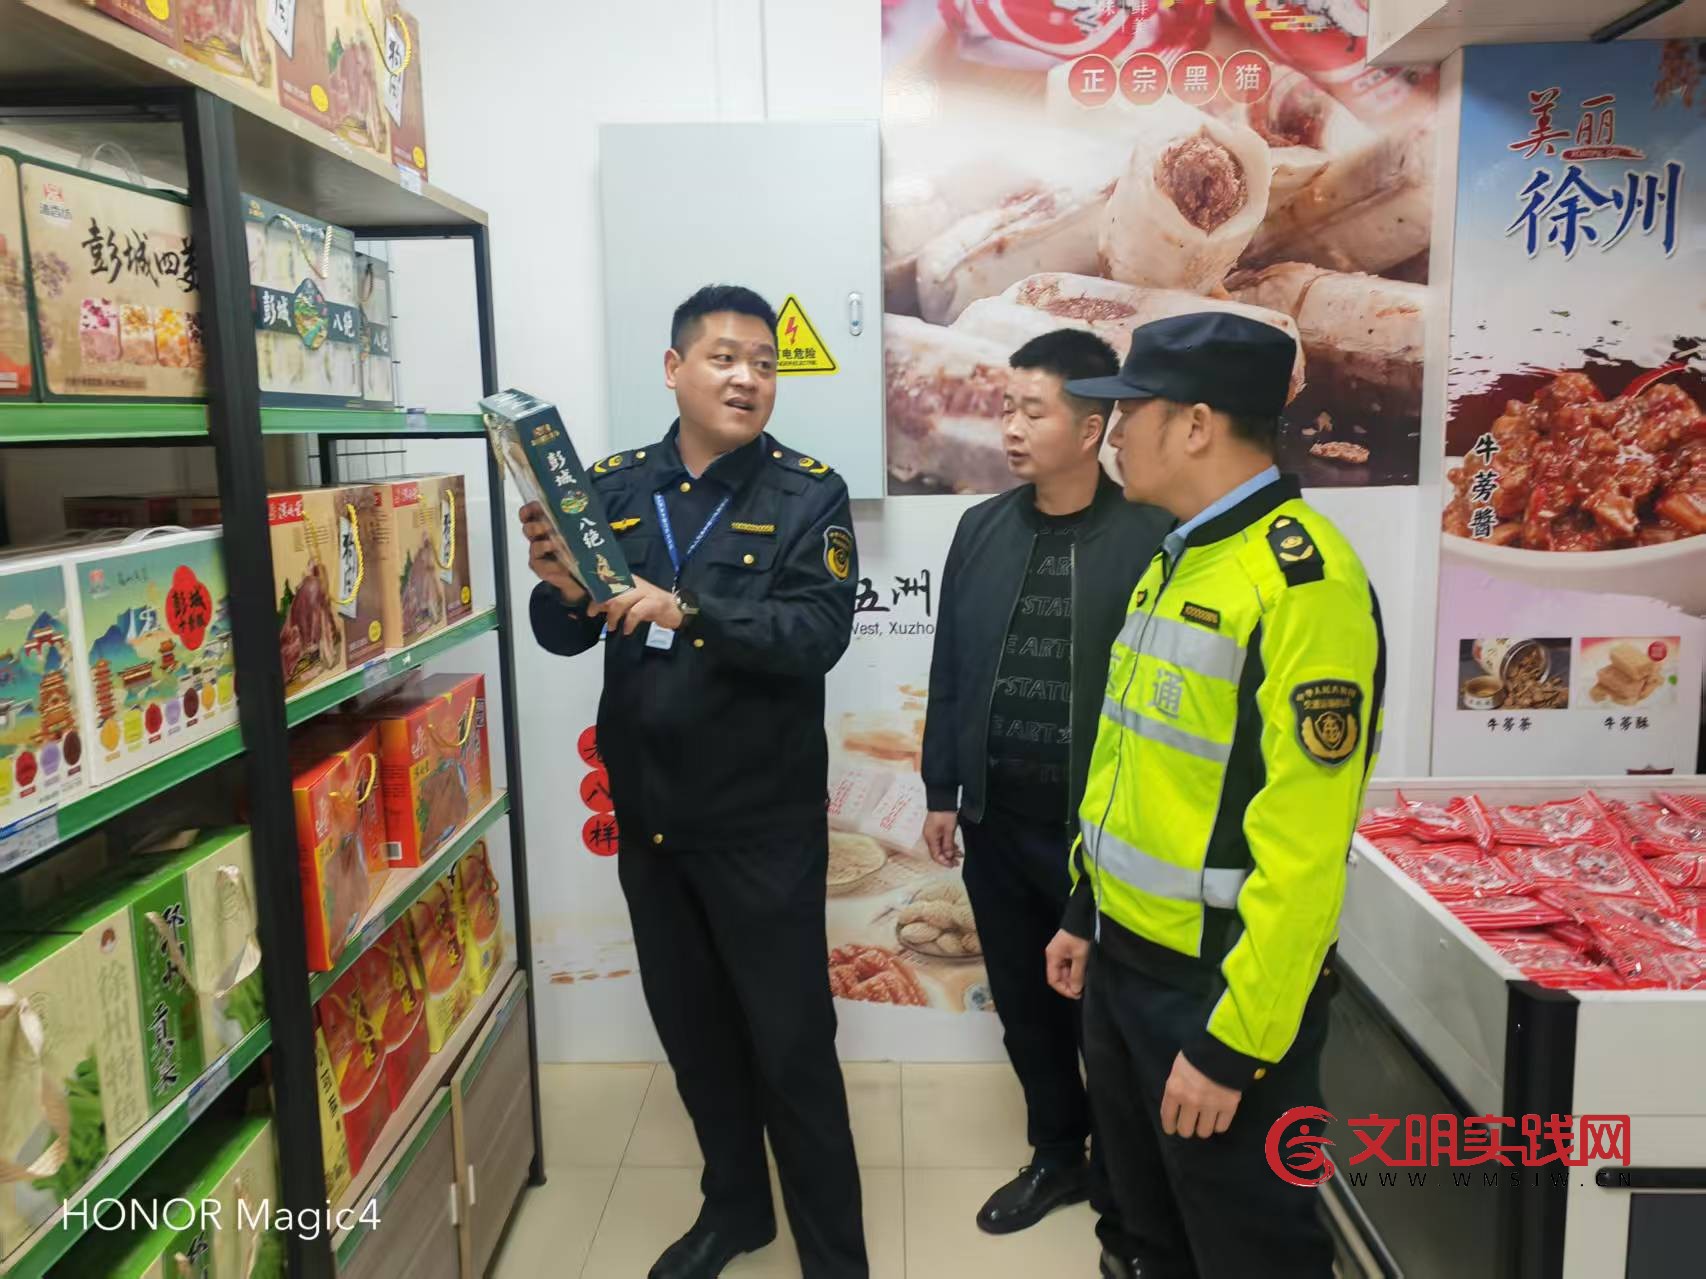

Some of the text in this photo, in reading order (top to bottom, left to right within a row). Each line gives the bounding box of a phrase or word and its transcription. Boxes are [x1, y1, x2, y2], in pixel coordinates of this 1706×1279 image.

[1081, 64, 1262, 93] 正宗黑猫
[1508, 87, 1622, 158] 美丽
[1506, 163, 1682, 259] 徐州
[546, 450, 577, 487] 彭城
